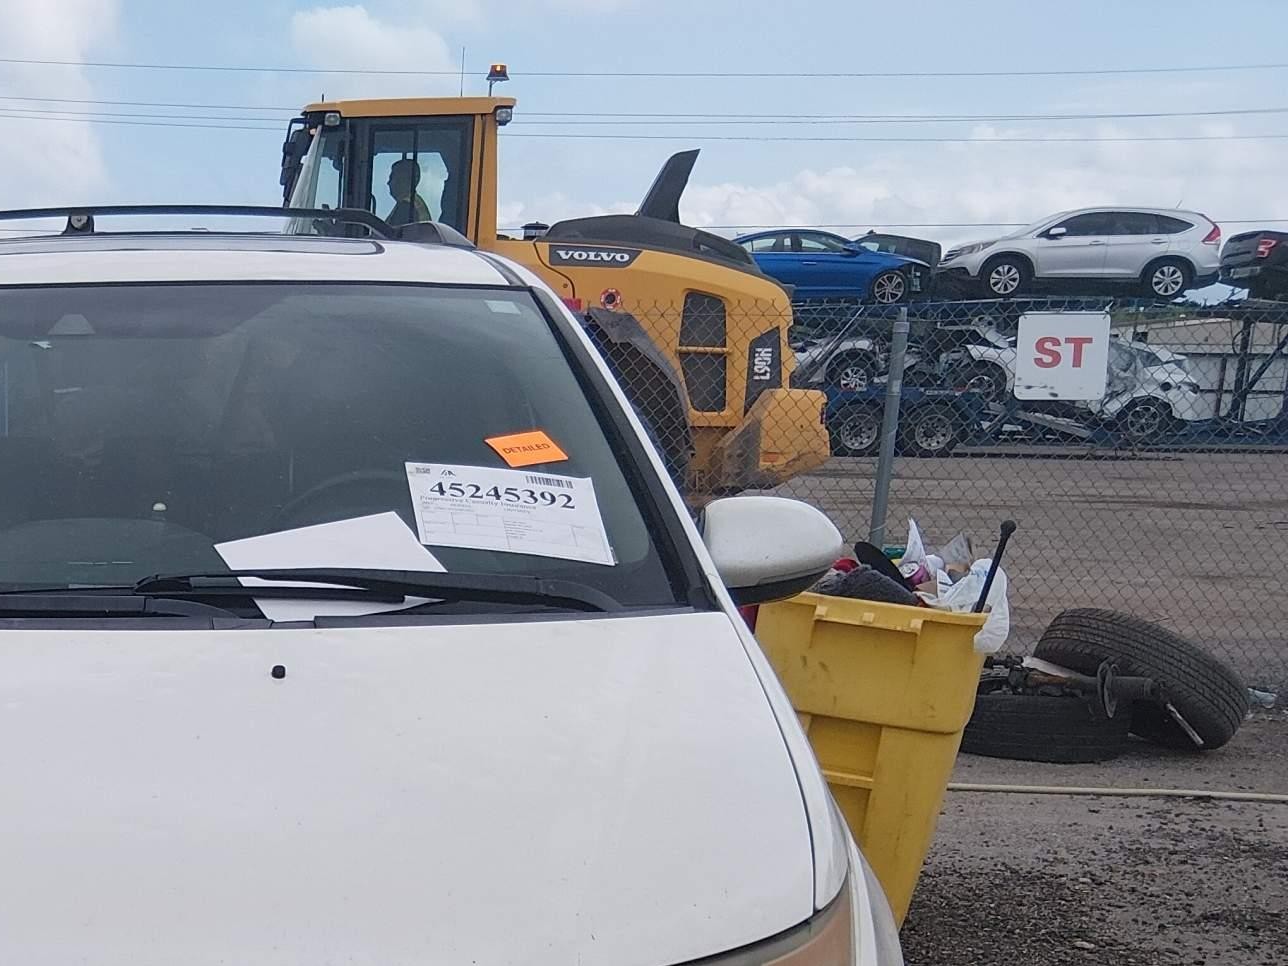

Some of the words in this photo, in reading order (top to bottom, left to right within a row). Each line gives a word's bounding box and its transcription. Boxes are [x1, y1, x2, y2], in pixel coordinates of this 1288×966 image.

[556, 250, 630, 262] VOLVO
[1033, 336, 1094, 369] ST
[502, 442, 551, 455] DETAILED
[429, 480, 576, 510] 45245392
